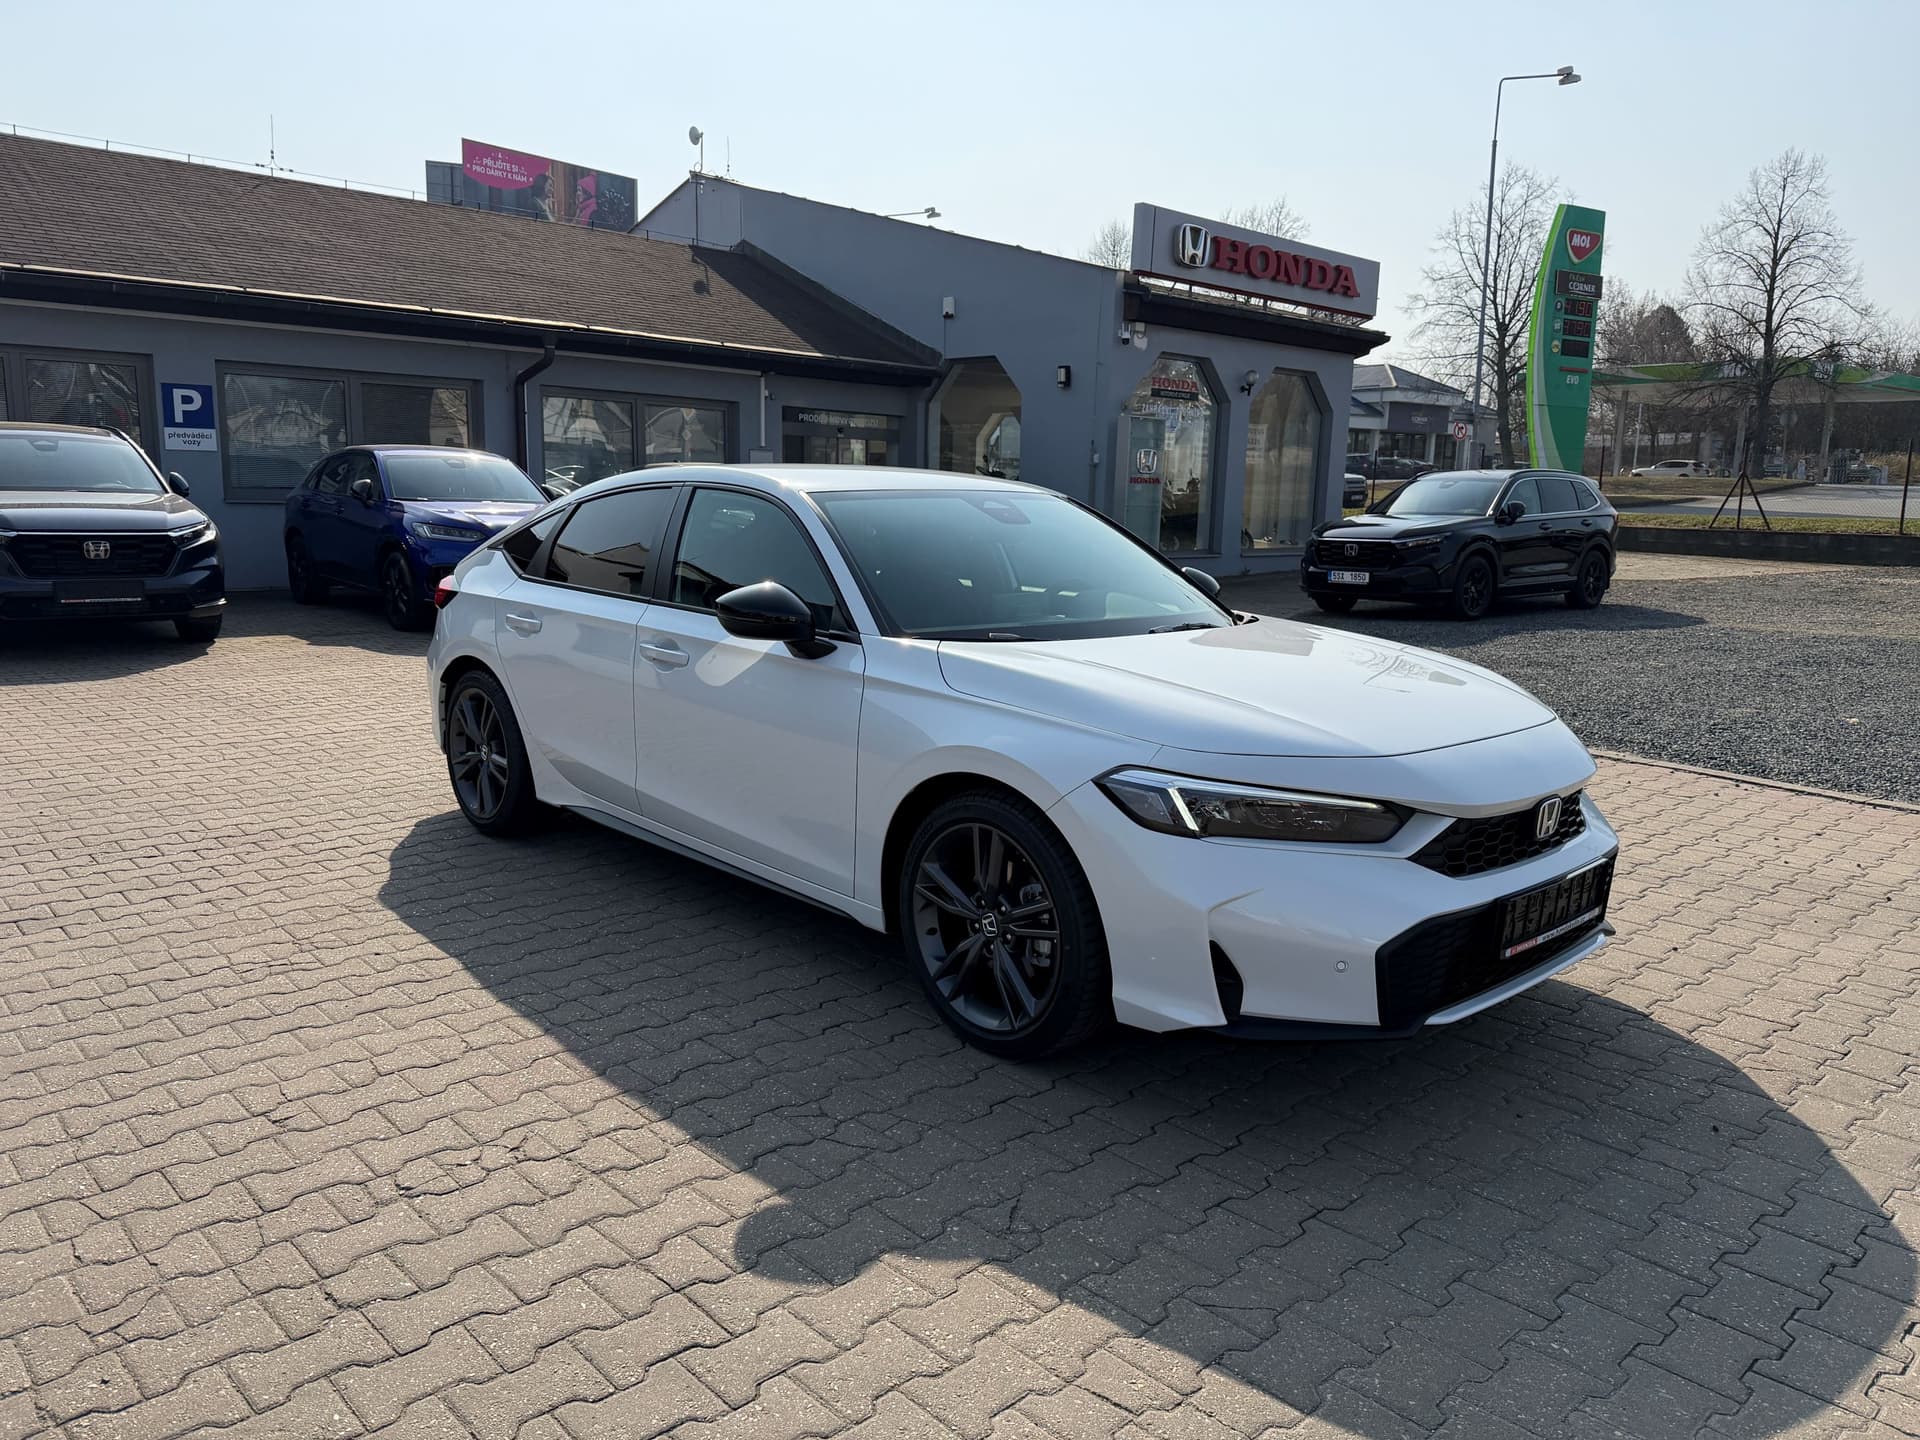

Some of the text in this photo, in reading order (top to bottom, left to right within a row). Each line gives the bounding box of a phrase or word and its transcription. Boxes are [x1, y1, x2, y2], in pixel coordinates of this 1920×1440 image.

[482, 156, 519, 173] PŘIJĎTE SI
[472, 164, 485, 174] PRO
[486, 167, 507, 178] DÁRKY
[513, 172, 528, 183] NÁM
[1571, 233, 1591, 249] MOL
[1212, 236, 1361, 298] HONDA
[1568, 281, 1596, 293] CORNER
[1151, 376, 1199, 391] HONDA
[1566, 375, 1580, 385] EVO
[172, 388, 202, 423] P
[168, 431, 212, 439] předváděcí
[182, 438, 201, 447] vozy
[1129, 476, 1161, 484] HONDA
